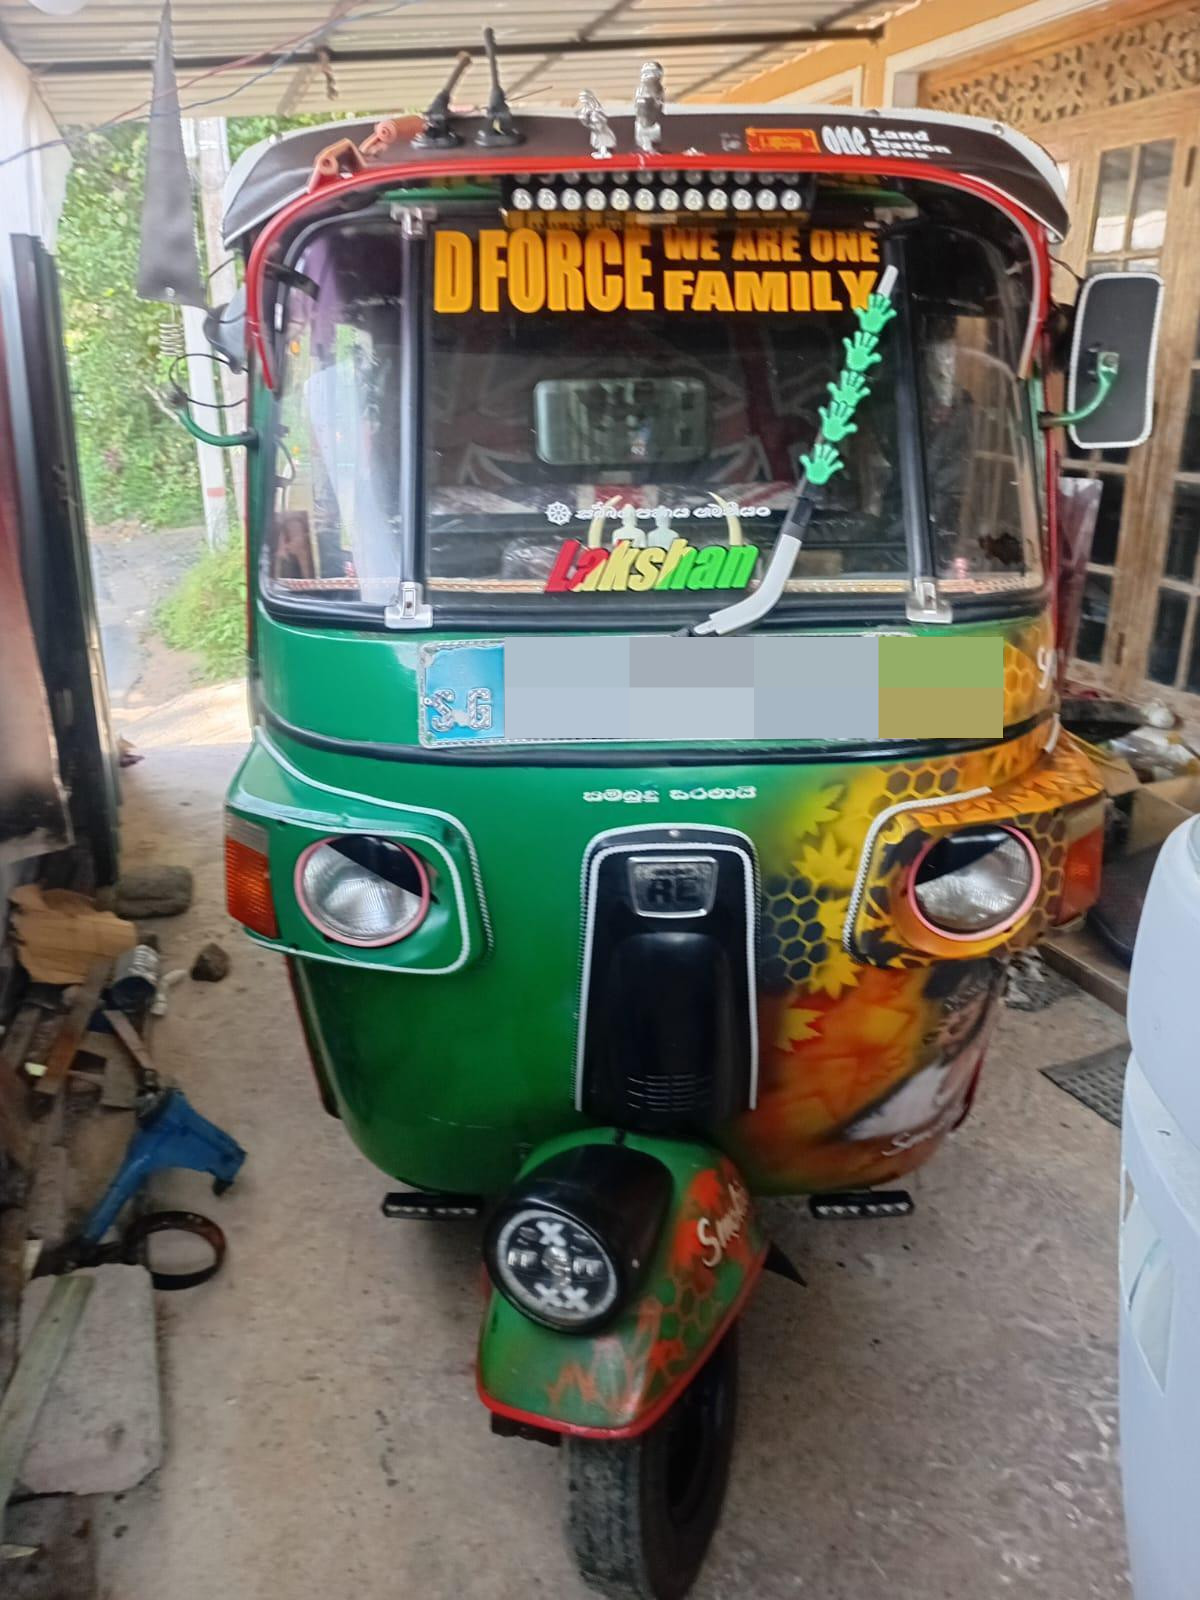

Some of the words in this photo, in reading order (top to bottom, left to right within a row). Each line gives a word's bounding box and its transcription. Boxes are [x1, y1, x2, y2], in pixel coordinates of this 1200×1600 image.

[663, 227, 720, 262] WE
[731, 228, 801, 263] ARE
[809, 229, 881, 263] ONE
[433, 229, 474, 314] D
[479, 227, 655, 313] FORCE
[663, 270, 878, 313] FAMILY
[543, 538, 759, 593] Lakshan
